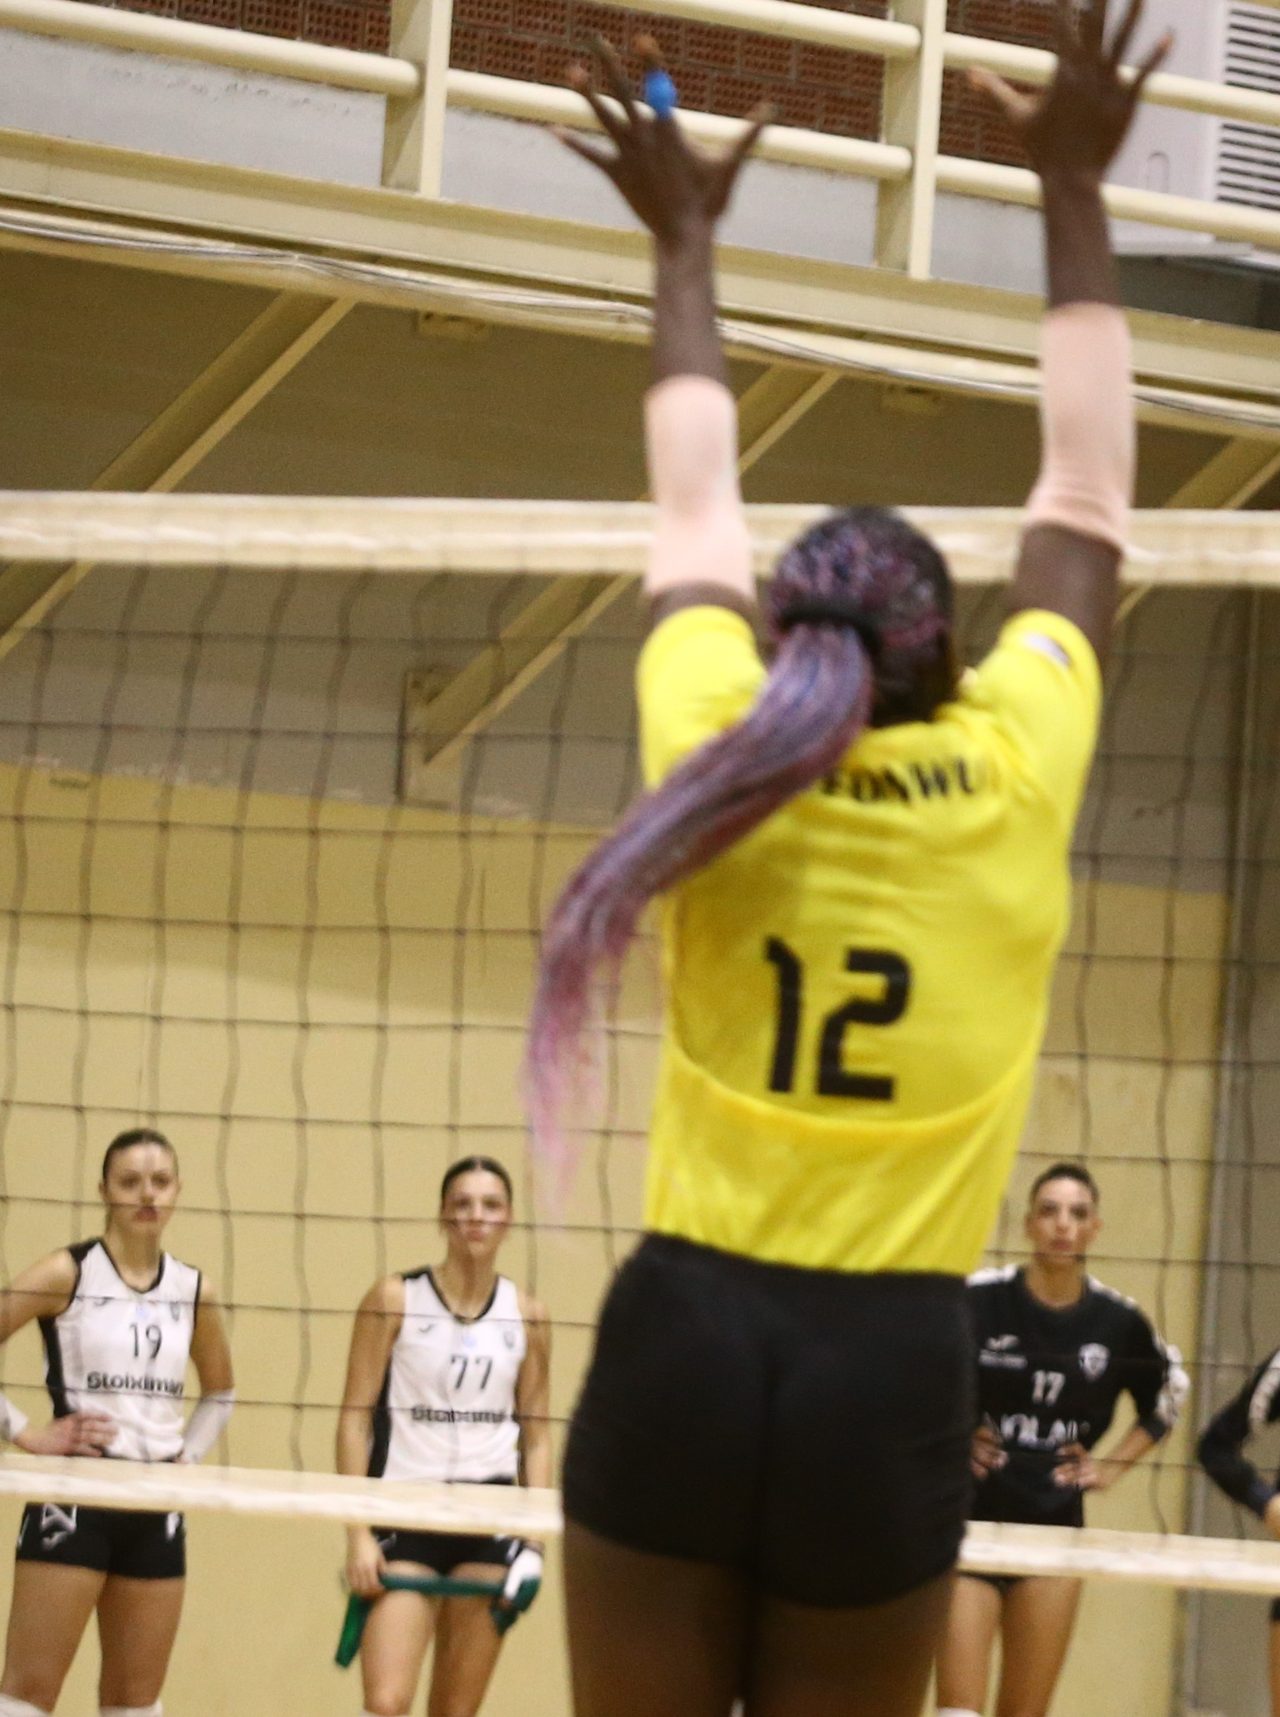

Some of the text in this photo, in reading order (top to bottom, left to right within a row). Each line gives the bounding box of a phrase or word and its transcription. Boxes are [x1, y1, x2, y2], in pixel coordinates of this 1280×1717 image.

[764, 933, 913, 1101] 12
[129, 1322, 163, 1360] 19
[450, 1354, 493, 1391] 77
[1032, 1369, 1067, 1407] 17
